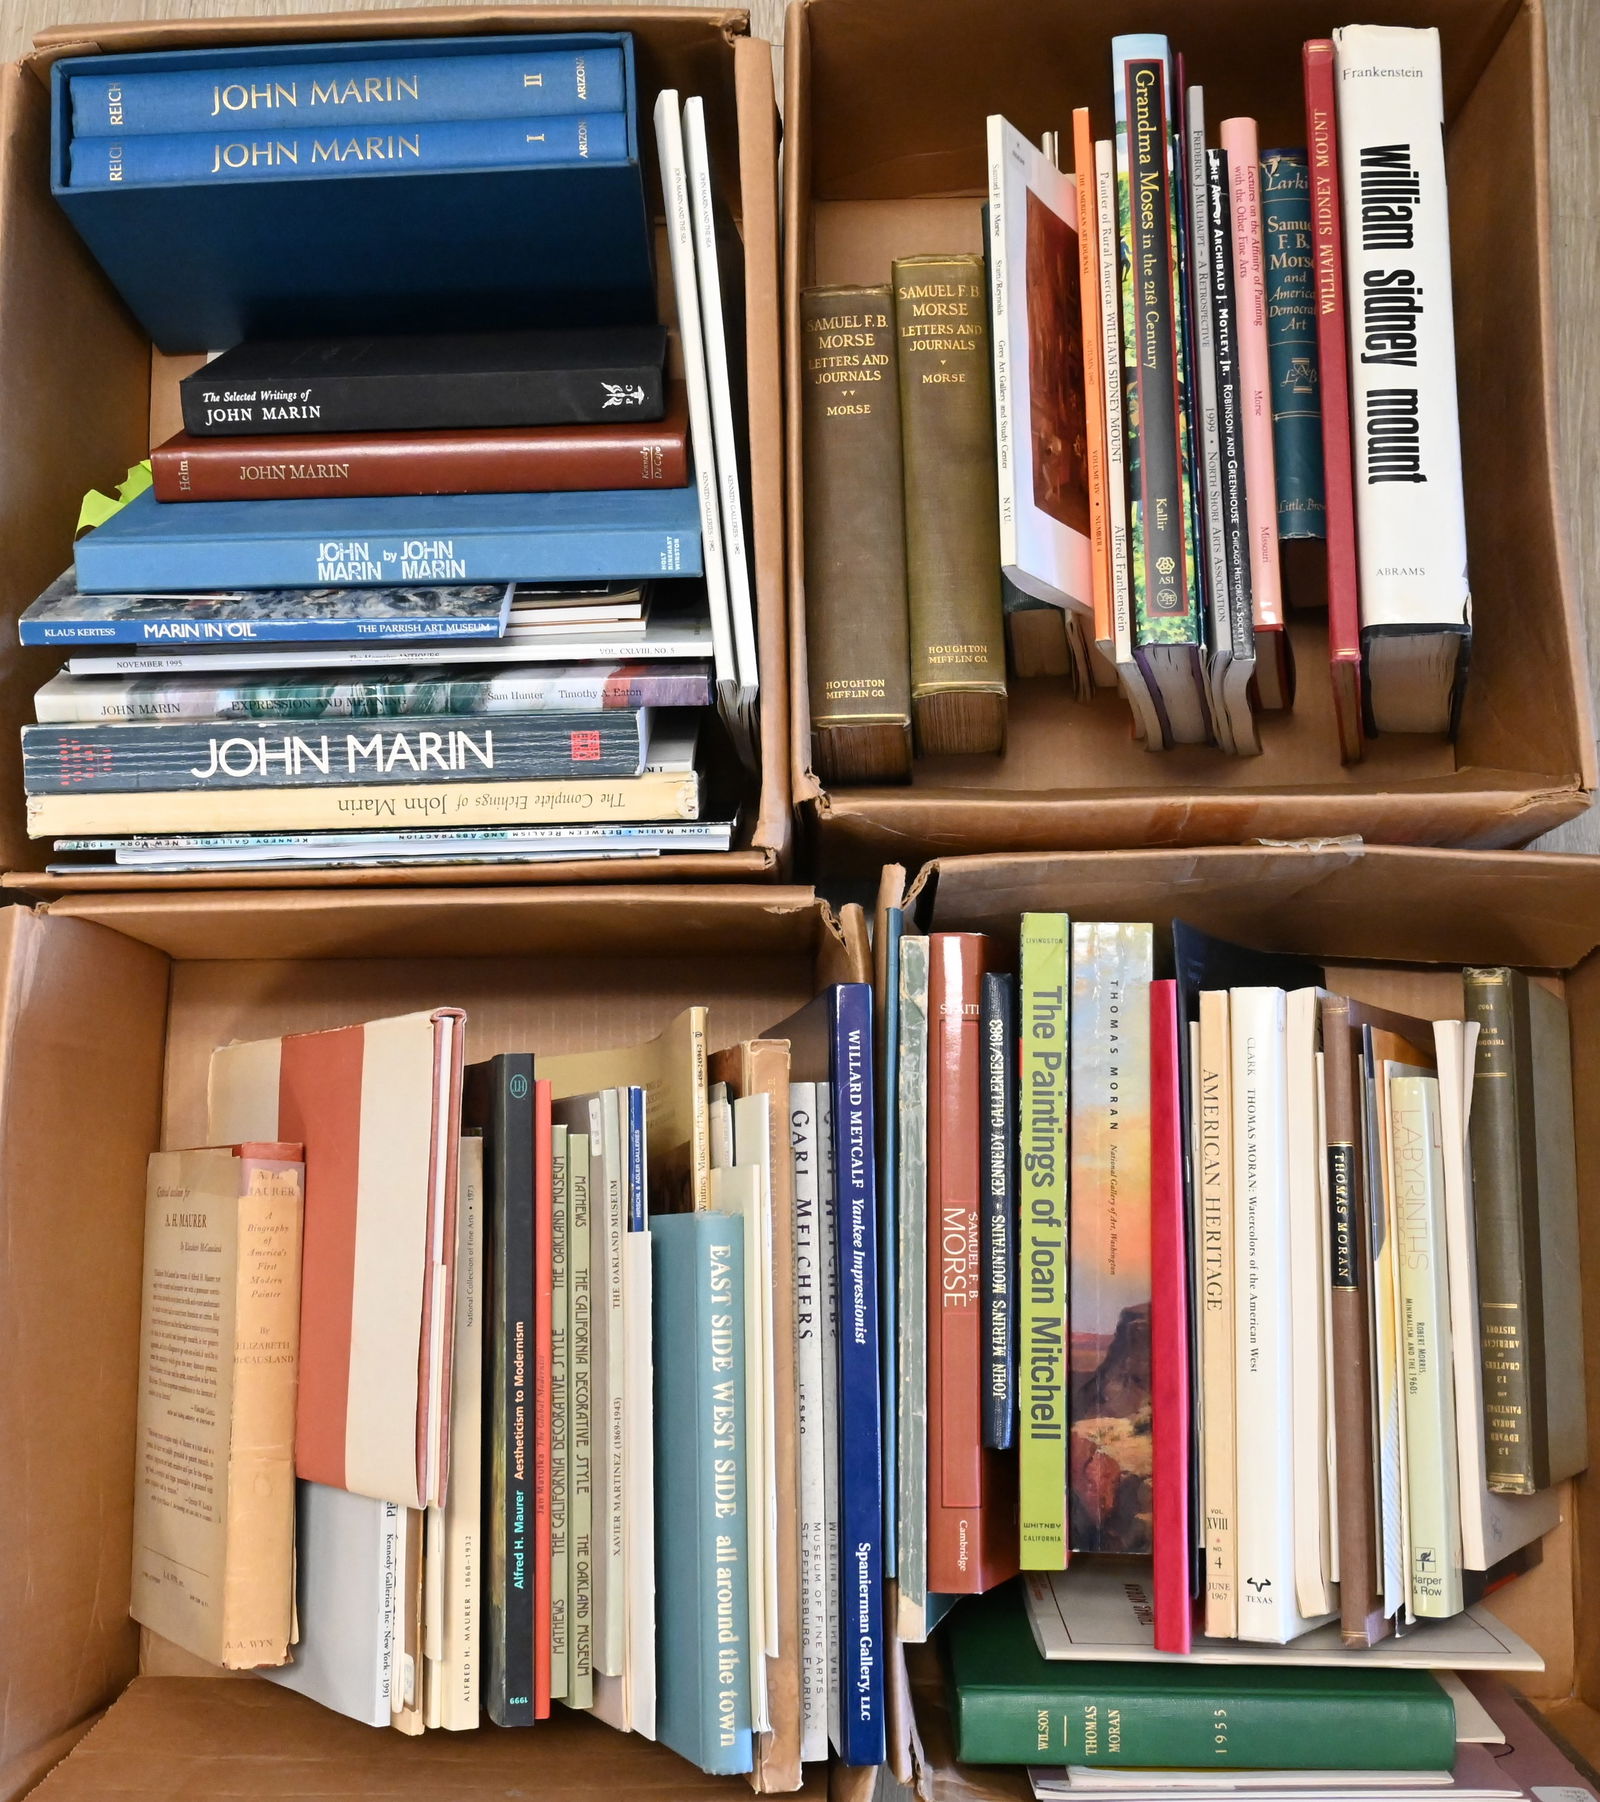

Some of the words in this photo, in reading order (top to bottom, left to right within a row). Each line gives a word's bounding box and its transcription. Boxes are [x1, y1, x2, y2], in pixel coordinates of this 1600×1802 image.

[1343, 66, 1424, 81] Frankenstein
[211, 82, 297, 117] JOHN
[310, 74, 419, 106] MARIN
[1135, 69, 1157, 166] Grandma
[211, 141, 298, 173] JOHN
[311, 133, 421, 163] MARIN
[1314, 108, 1329, 168] MOUNT
[1100, 172, 1110, 208] Painter
[1140, 170, 1160, 230] Moses
[1318, 176, 1333, 235] SIDNEY
[1360, 143, 1421, 251] william
[1102, 212, 1110, 226] of
[1102, 228, 1112, 258] Rural
[1143, 234, 1155, 249] in
[1143, 253, 1157, 276] the
[1321, 243, 1335, 316] WILLIAM
[899, 284, 955, 300] SAMUEL
[958, 284, 968, 297] F.
[1103, 260, 1113, 309] America:
[1143, 281, 1158, 307] 21st
[807, 315, 862, 332] SAMUEL
[864, 314, 876, 327] F.
[876, 314, 889, 328] B.
[912, 303, 969, 317] MORSE
[1361, 269, 1424, 367] sidney
[819, 333, 876, 350] MORSE
[901, 324, 954, 338] LETTERS
[956, 324, 983, 336] AND
[909, 339, 976, 352] JOURNALS
[1105, 312, 1116, 366] WILLIAM
[1143, 310, 1160, 370] Century
[808, 354, 860, 370] LETTERS
[862, 354, 889, 366] AND
[815, 370, 882, 385] JOURNALS
[922, 373, 966, 384] MORSE
[203, 391, 221, 403] The
[223, 391, 257, 402] Selected
[260, 390, 298, 402] Writings
[300, 389, 312, 402] of
[1108, 368, 1119, 412] SIDNEY
[205, 407, 253, 426] JOHN
[262, 405, 321, 421] MARIN
[826, 404, 871, 417] MORSE
[1110, 416, 1121, 465] MOUNT
[1366, 388, 1428, 485] mount
[239, 464, 286, 481] JOHN
[289, 463, 350, 480] MARIN
[1156, 497, 1169, 531] Kallir
[316, 542, 369, 563] JOHN
[383, 549, 398, 563] by
[400, 540, 453, 561] JOHN
[1114, 524, 1125, 560] Alfred
[318, 562, 382, 582] MARIN
[401, 560, 467, 580] MARIN
[1375, 567, 1426, 577] ABRAMS
[1115, 562, 1128, 633] Frankenstein
[44, 628, 76, 637] KLAUS
[77, 627, 116, 637] KERTESS
[144, 622, 199, 639] MARIN
[204, 623, 223, 637] IN
[228, 621, 257, 638] OIL
[357, 624, 378, 633] THE
[379, 623, 421, 634] PARRISH
[424, 623, 444, 633] ART
[446, 622, 490, 633] MUSEUM
[928, 645, 988, 654] HOUGHTON
[928, 655, 973, 665] MIFFLIN
[974, 655, 988, 664] CO.
[825, 679, 886, 690] HOUGHTON
[826, 689, 870, 700] MIFFLIN
[871, 689, 886, 698] CO.
[190, 735, 330, 779] JOHN
[346, 730, 494, 773] MARIN
[338, 798, 396, 817] Marin
[403, 794, 448, 815] John
[455, 794, 469, 812] of
[476, 795, 528, 810] Etchings
[534, 793, 594, 810] Complete
[600, 792, 626, 807] The
[1025, 937, 1064, 945] LIVINGSTON
[1031, 985, 1063, 1040] The
[848, 1029, 863, 1106] WILLARD
[1246, 1036, 1256, 1077] CLARK
[1024, 1050, 1063, 1188] Paintings
[1202, 1068, 1221, 1187] AMERICAN
[1246, 1088, 1257, 1139] THOMAS
[850, 1110, 864, 1190] METCALF
[990, 1132, 1005, 1196] KENNEDY
[1247, 1142, 1258, 1193] MORAN:
[575, 1175, 587, 1228] MATHEWS
[1333, 1153, 1347, 1215] THOMAS
[850, 1198, 867, 1249] Yankee
[1030, 1199, 1062, 1229] of
[1248, 1196, 1258, 1260] Watercolors
[943, 1207, 967, 1308] MORSE
[968, 1210, 979, 1270] SAMUEL
[991, 1214, 1006, 1295] MOUNTAINS
[1204, 1197, 1224, 1312] HERITAGE
[1337, 1221, 1349, 1279] MORAN
[250, 1275, 284, 1285] Modern
[256, 1262, 278, 1272] First
[575, 1268, 588, 1293] THE
[711, 1245, 731, 1306] EAST
[968, 1273, 979, 1285] F.
[1030, 1236, 1062, 1305] Joan
[1249, 1262, 1258, 1272] of
[1249, 1272, 1259, 1290] the
[251, 1290, 282, 1299] Painter
[851, 1251, 868, 1346] Impressionist
[968, 1289, 979, 1302] B.
[576, 1294, 589, 1365] CALIFORNIA
[992, 1299, 1007, 1357] MARIN'S
[1249, 1291, 1259, 1341] American
[513, 1321, 525, 1388] Modernism
[711, 1314, 733, 1372] SIDE
[1249, 1342, 1259, 1373] West
[514, 1390, 525, 1404] to
[992, 1363, 1007, 1400] JOHN
[1030, 1316, 1063, 1441] Mitchell
[576, 1371, 589, 1448] DECORATIVE
[712, 1380, 736, 1450] WEST
[513, 1406, 525, 1481] Aestheticism
[576, 1454, 589, 1495] STYLE
[714, 1459, 737, 1519] SIDE
[513, 1489, 525, 1534] Maurer
[1023, 1522, 1062, 1530] WHITNEY
[1206, 1516, 1229, 1531] XVIII
[513, 1537, 525, 1550] H.
[577, 1533, 590, 1558] THE
[715, 1535, 737, 1563] all
[813, 1522, 822, 1582] MUSEUM
[957, 1519, 968, 1573] Cambridge
[1023, 1534, 1062, 1542] CALIFORNIA
[513, 1552, 525, 1590] Alfred
[577, 1560, 590, 1619] OAKLAND
[856, 1542, 872, 1634] Spanierman
[1207, 1582, 1231, 1592] JUNE
[716, 1567, 740, 1643] around
[814, 1589, 823, 1607] OF
[1210, 1592, 1228, 1601] 1967
[1245, 1595, 1273, 1604] TEXAS
[815, 1615, 824, 1649] FINE
[577, 1624, 590, 1678] MUSEUM
[718, 1655, 740, 1684] the
[857, 1635, 873, 1694] Gallery,
[815, 1656, 825, 1694] ARTS
[719, 1691, 739, 1747] town
[860, 1695, 871, 1721] LLC
[1037, 1709, 1049, 1751] WILSON
[1084, 1705, 1098, 1757] THOMAS
[1107, 1708, 1121, 1753] MORAN
[1214, 1709, 1228, 1754] 1955
